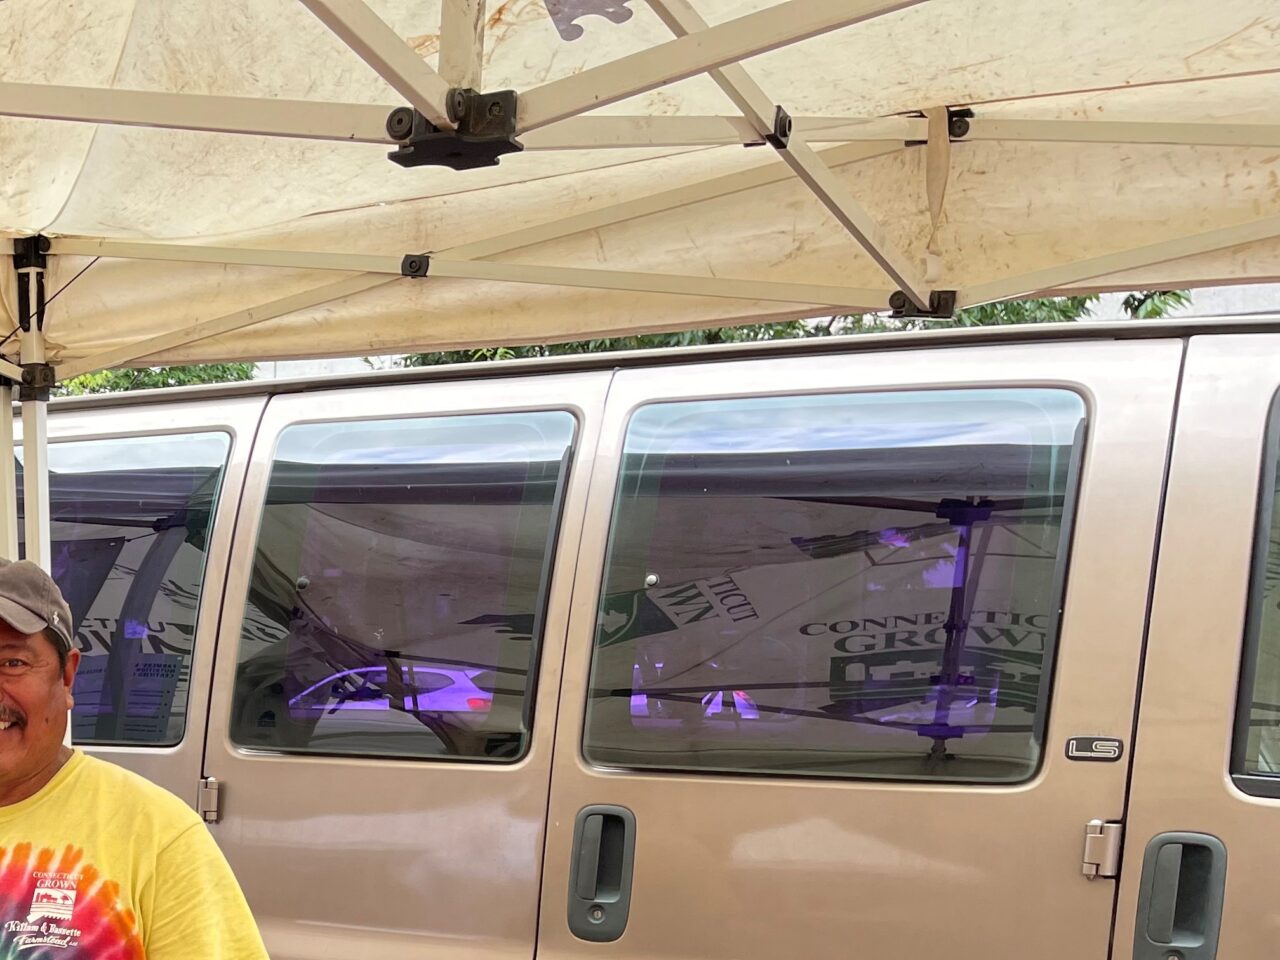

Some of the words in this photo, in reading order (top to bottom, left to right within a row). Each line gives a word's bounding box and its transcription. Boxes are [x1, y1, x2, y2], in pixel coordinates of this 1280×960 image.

[1069, 740, 1119, 758] LS
[32, 871, 84, 880] CONNECTICUT
[36, 879, 77, 889] GROWN
[4, 921, 39, 932] Killam
[49, 923, 81, 937] Bassette
[13, 934, 71, 946] Farmstead
